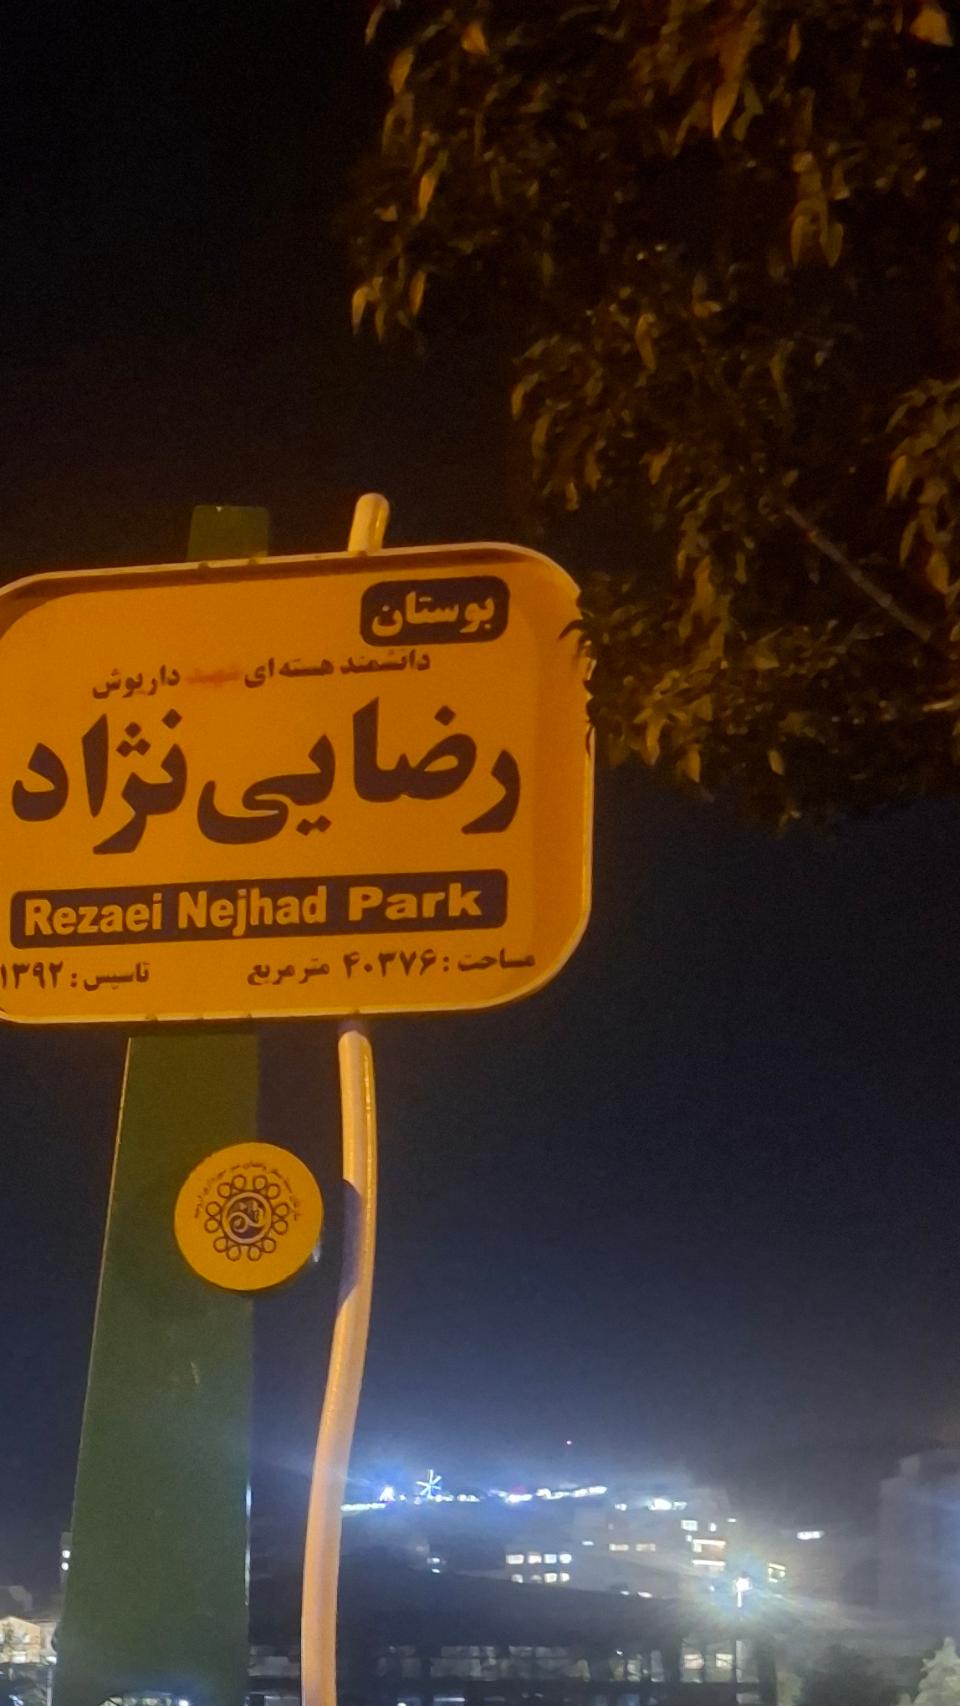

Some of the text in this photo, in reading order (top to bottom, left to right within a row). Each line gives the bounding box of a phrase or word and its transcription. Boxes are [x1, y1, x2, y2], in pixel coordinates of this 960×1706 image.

[371, 590, 496, 637] بوستان
[92, 665, 181, 699] داریوش
[340, 649, 430, 674] دانشمند
[11, 697, 521, 855] رضایی نژاد
[24, 883, 483, 937] Rezaei Nejhad Park
